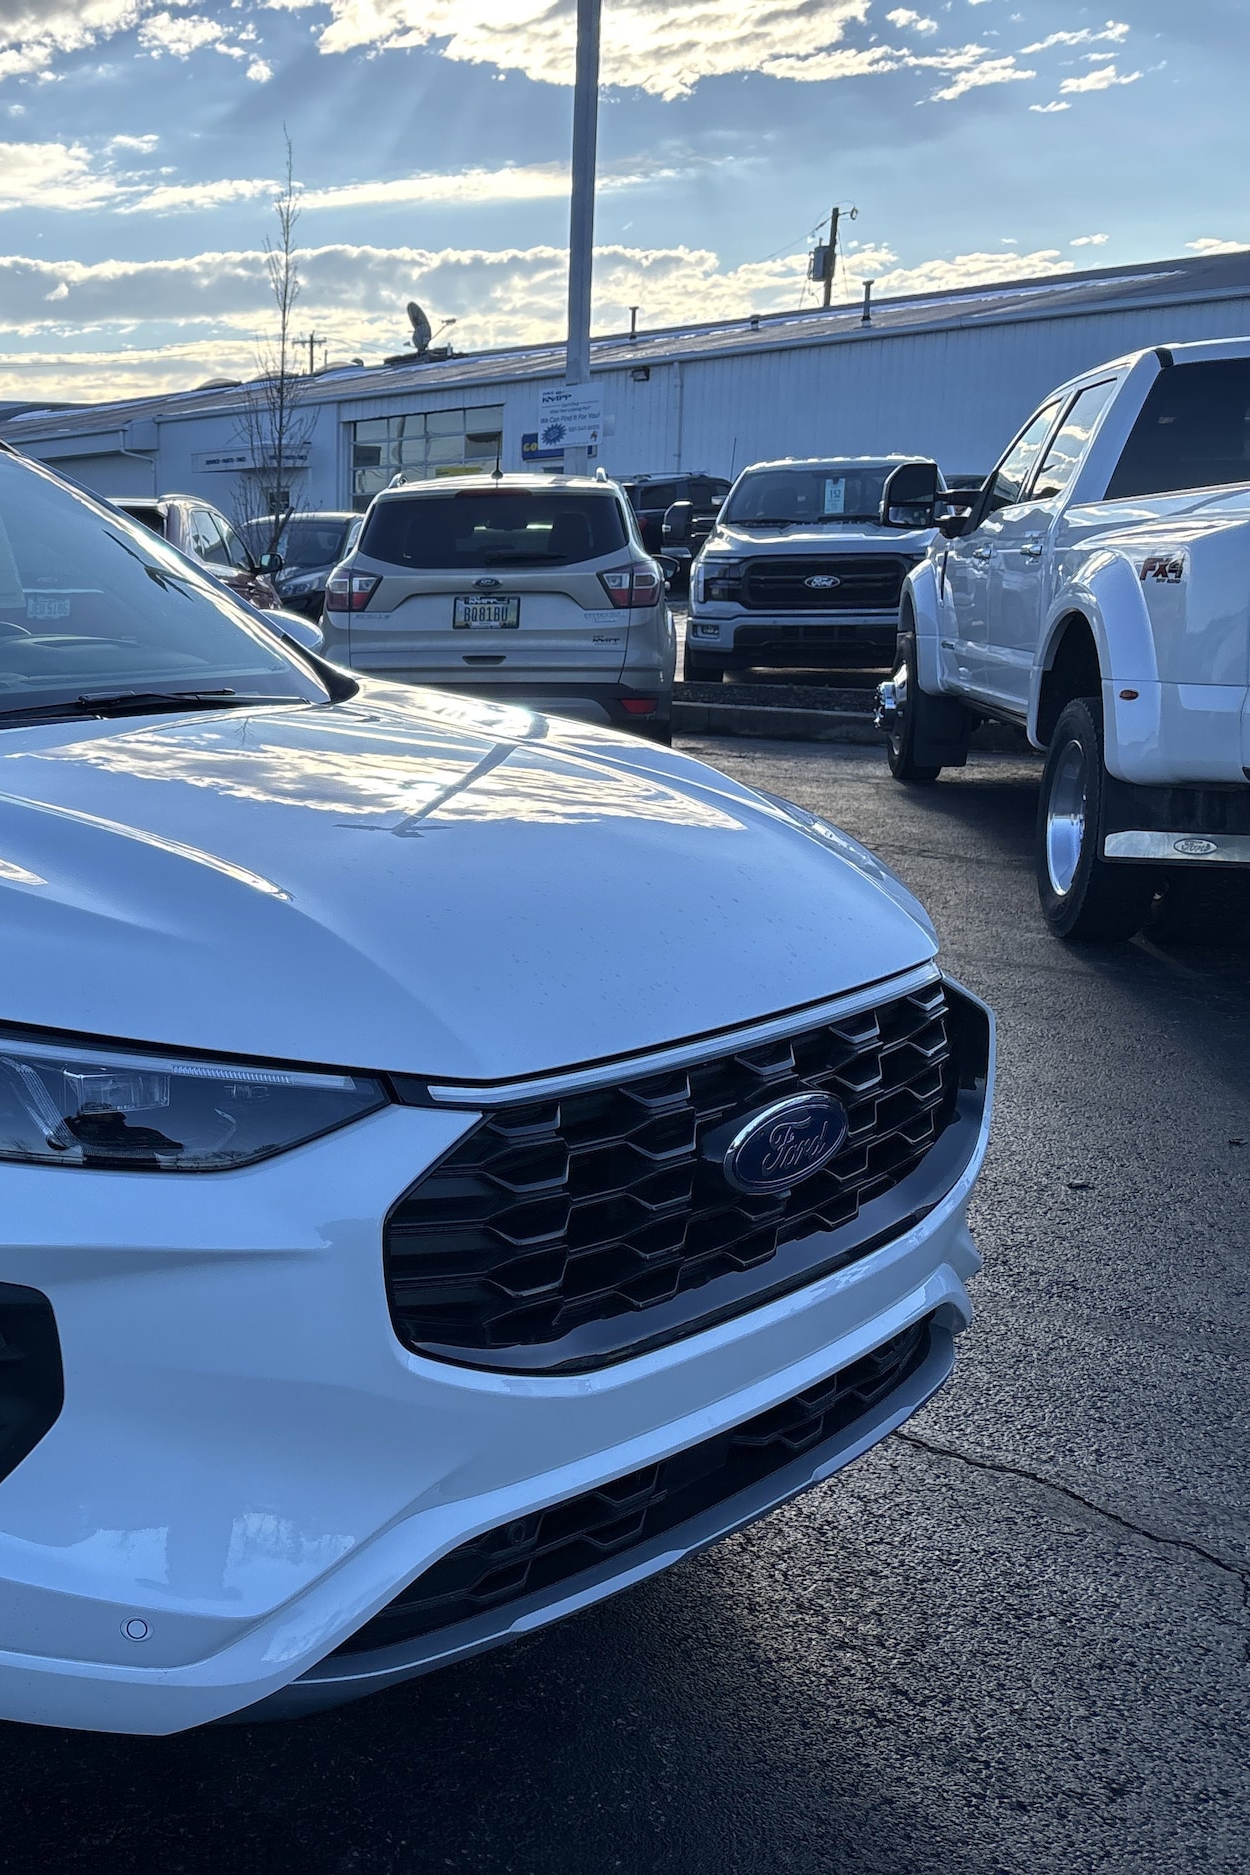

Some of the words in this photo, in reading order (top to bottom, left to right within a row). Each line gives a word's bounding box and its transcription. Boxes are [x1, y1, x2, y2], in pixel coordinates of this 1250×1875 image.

[1140, 554, 1185, 581] FX4
[811, 576, 834, 587] Ford
[464, 606, 509, 622] BQ81BU
[1182, 840, 1211, 853] Ford
[762, 1115, 829, 1177] Ford
